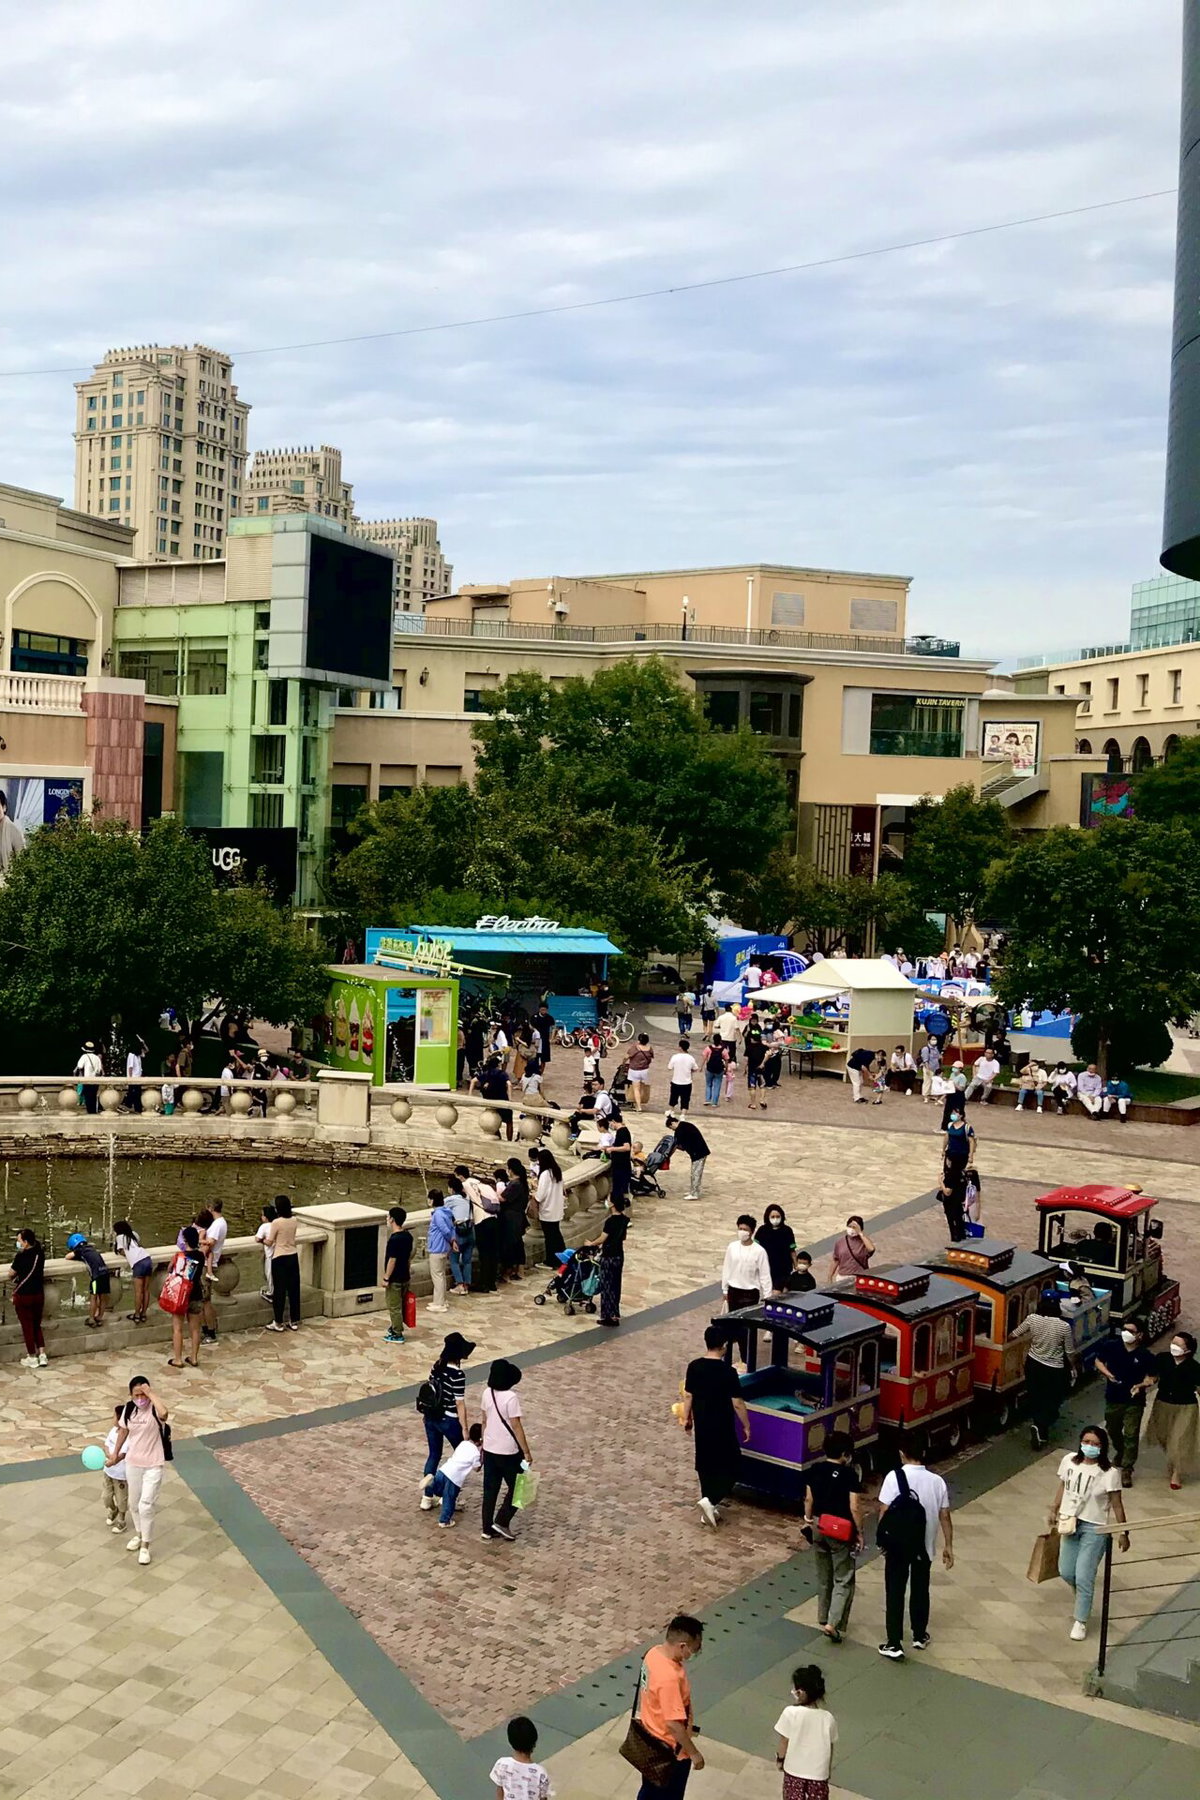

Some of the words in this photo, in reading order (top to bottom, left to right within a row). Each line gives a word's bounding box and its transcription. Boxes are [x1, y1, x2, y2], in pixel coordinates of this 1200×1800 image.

[938, 699, 966, 707] TAVERN
[212, 847, 241, 871] UGG
[475, 915, 560, 933] Electra
